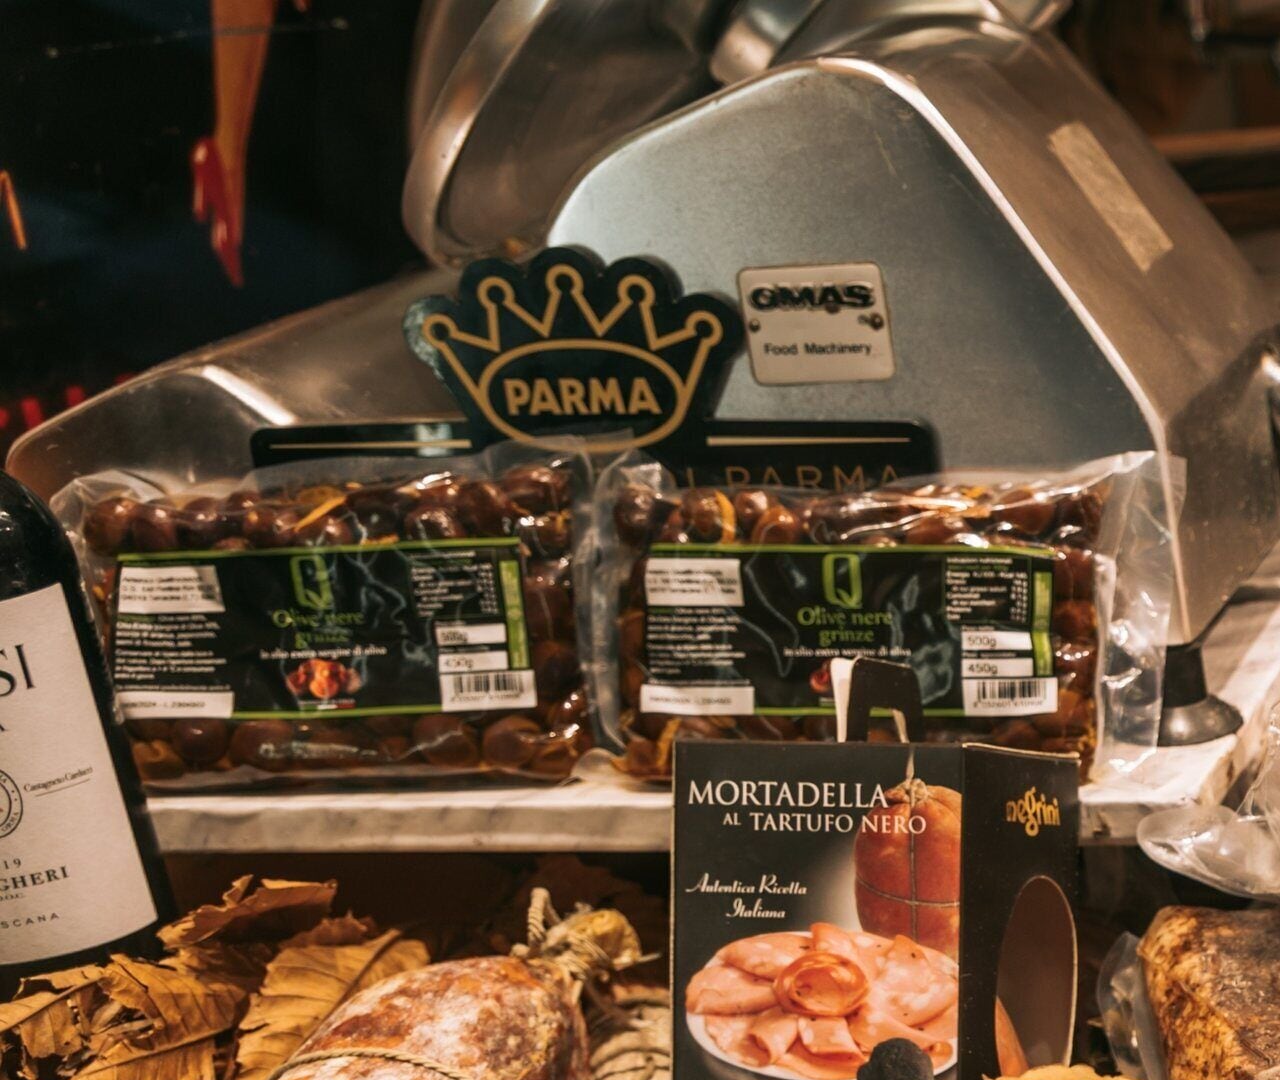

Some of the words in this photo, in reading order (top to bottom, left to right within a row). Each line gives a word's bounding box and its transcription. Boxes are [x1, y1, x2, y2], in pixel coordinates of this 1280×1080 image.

[763, 342, 799, 356] Food
[803, 342, 873, 356] Machinery
[504, 377, 662, 417] PARMA
[822, 552, 863, 610] Q
[797, 605, 847, 626] Olive
[851, 610, 894, 626] nere
[819, 629, 876, 648] grinze
[967, 635, 997, 648] 500g
[967, 661, 998, 675] 450g
[687, 779, 890, 809] MORTADELLA
[1005, 784, 1061, 837] negrini
[722, 812, 743, 827] AL
[749, 812, 854, 833] TARTUFO
[860, 814, 928, 836] NERO
[685, 872, 756, 894] Autentica
[758, 874, 808, 895] Ricetta
[725, 897, 786, 919] Italiana
